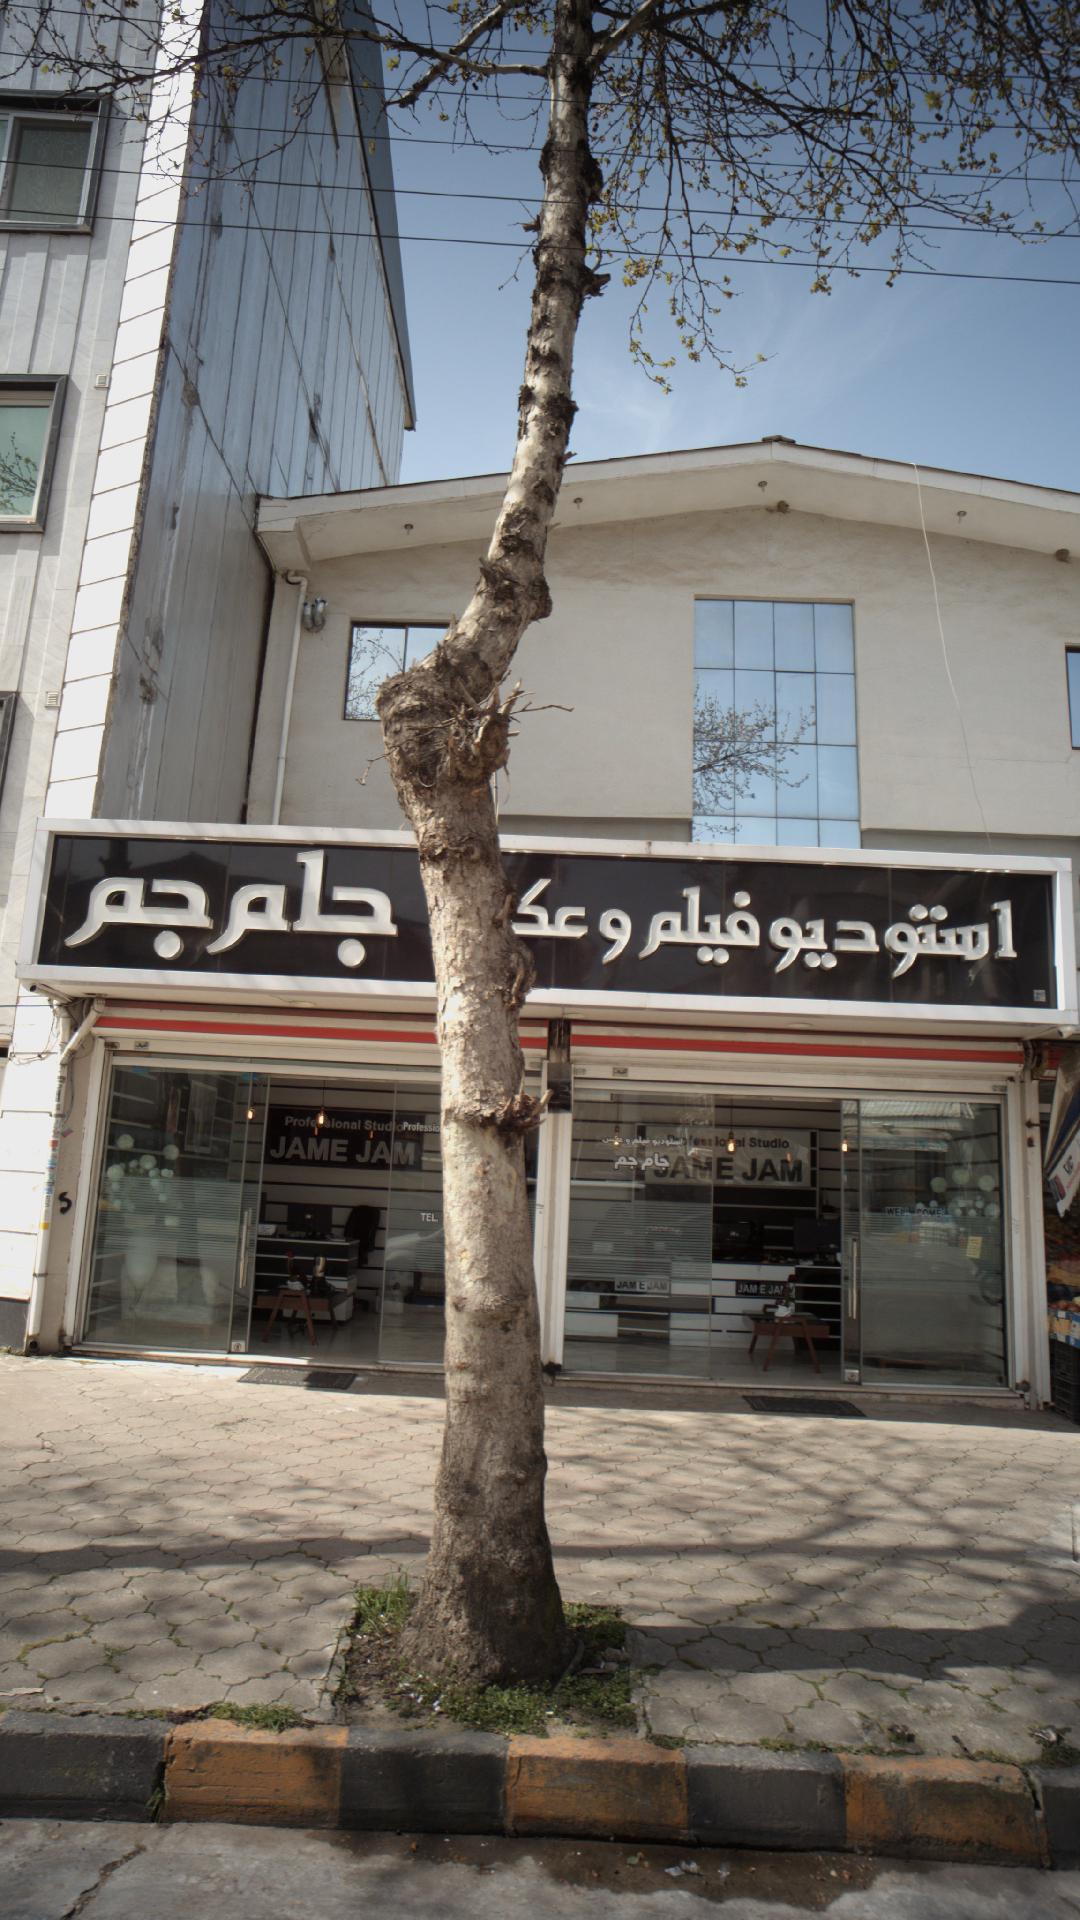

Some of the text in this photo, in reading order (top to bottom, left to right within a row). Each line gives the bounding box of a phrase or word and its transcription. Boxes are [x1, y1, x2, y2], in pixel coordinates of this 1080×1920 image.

[64, 849, 1018, 979] استودیو فیلم و عک جام جم
[285, 1116, 361, 1130] Profesional
[403, 1122, 440, 1133] Professio
[270, 1136, 416, 1165] JAME JAM
[750, 1137, 790, 1149] Studio
[614, 1153, 670, 1171] جام جم
[742, 1157, 803, 1183] JAM
